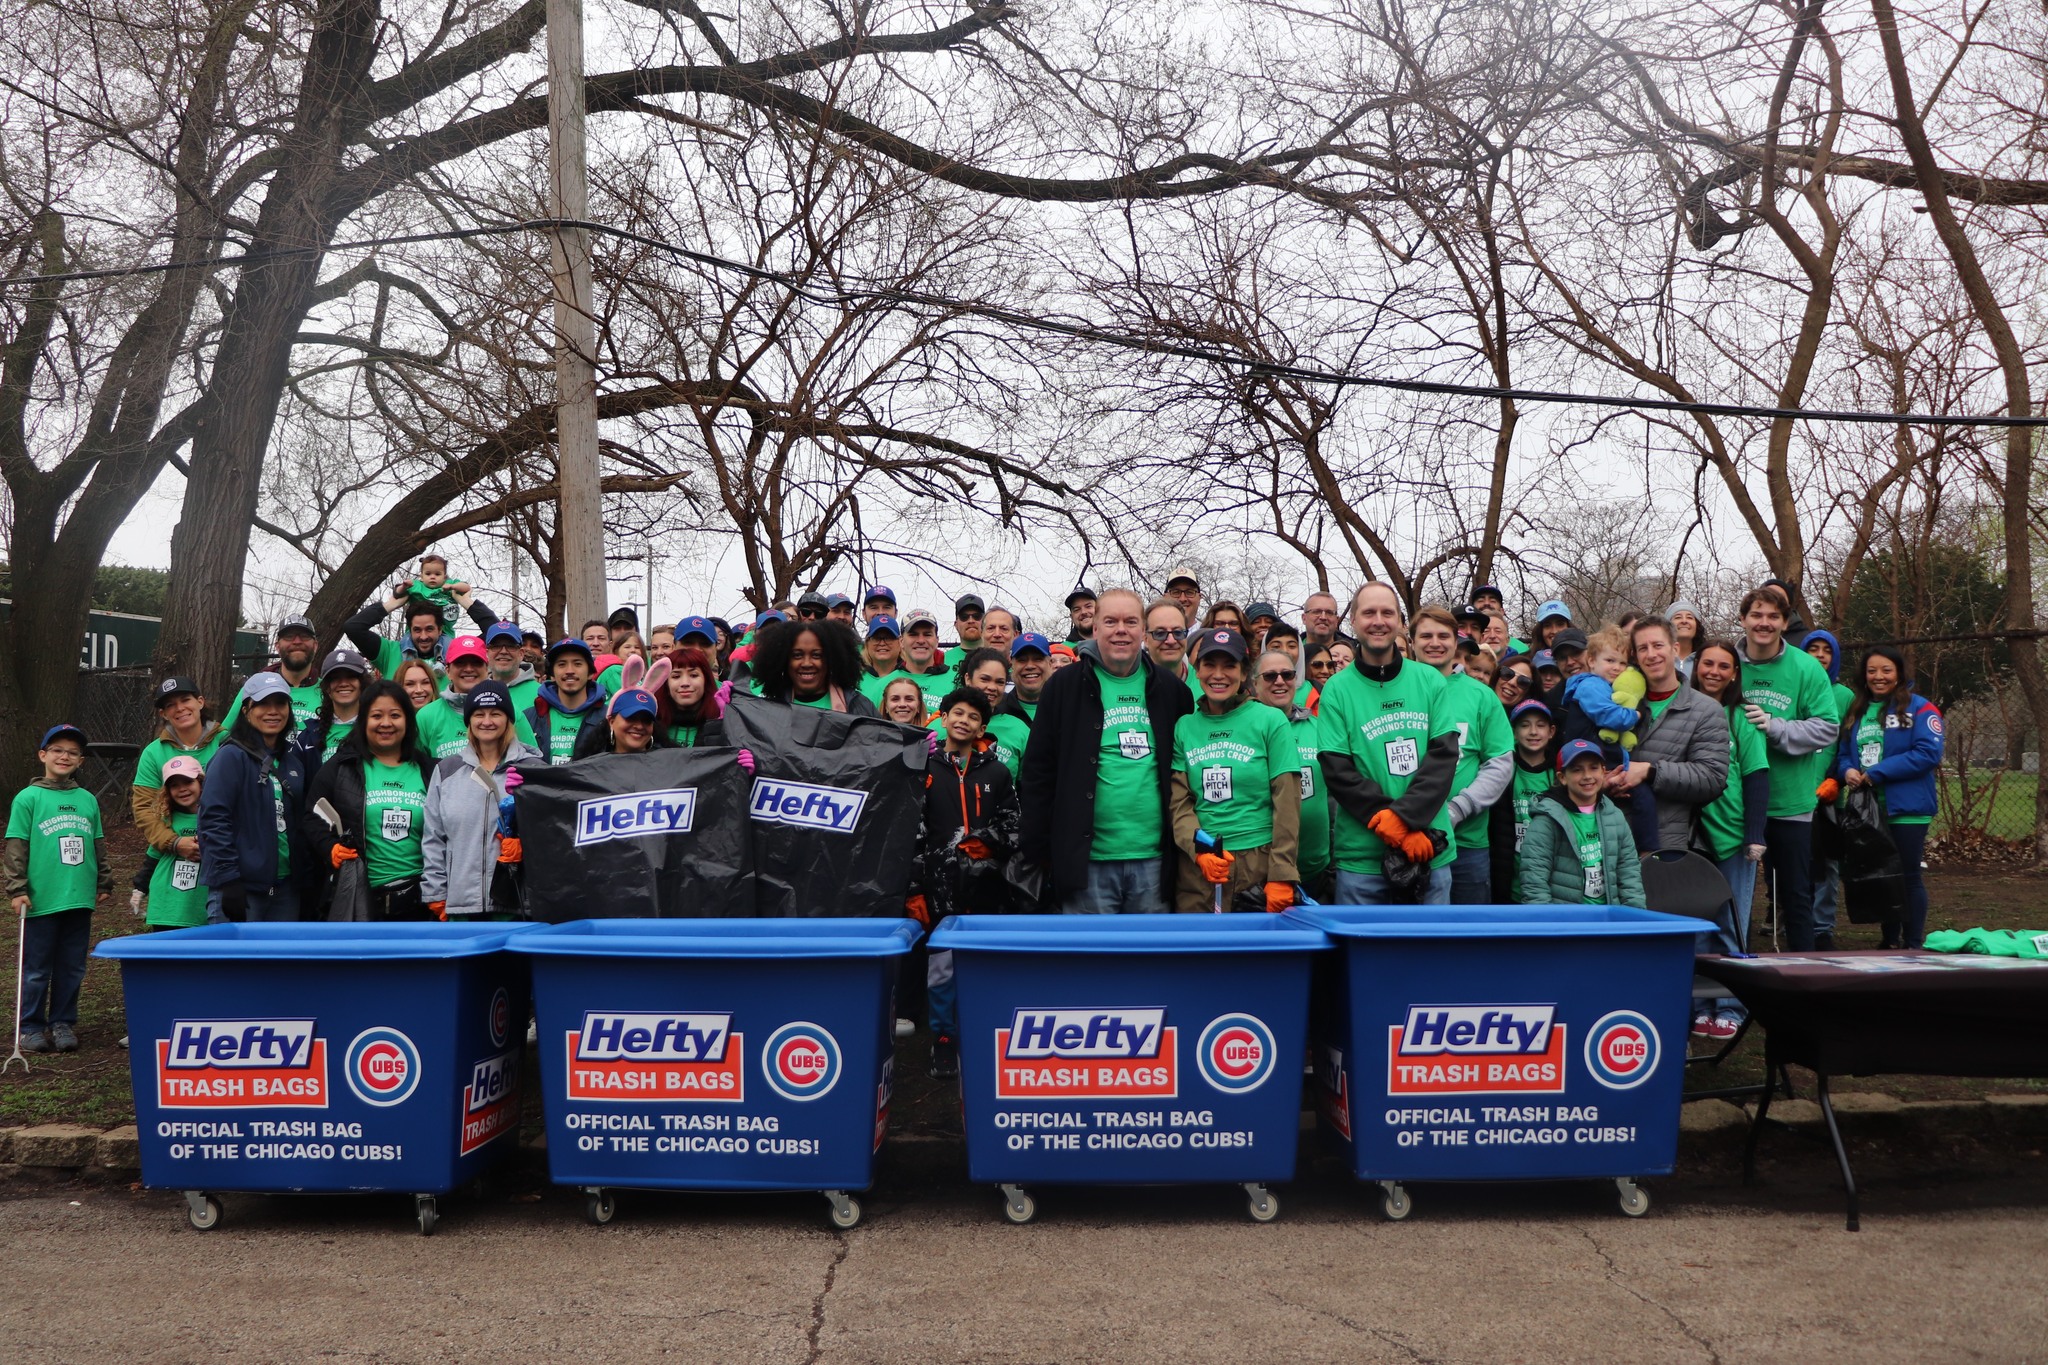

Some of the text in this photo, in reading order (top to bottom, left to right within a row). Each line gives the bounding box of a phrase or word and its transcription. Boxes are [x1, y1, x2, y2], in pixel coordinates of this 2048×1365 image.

[1382, 700, 1404, 709] Hefty
[1742, 689, 1792, 705] IGHBORHOOD
[1768, 698, 1788, 711] CREW
[1140, 717, 1151, 726] CR
[1209, 731, 1231, 739] Hefty
[1366, 720, 1405, 740] GROUNDS
[436, 738, 470, 754] NEIGHBO
[550, 742, 573, 750] OUNDS
[1124, 736, 1144, 744] LET'S
[1186, 741, 1255, 759] NEIGHBORHOOD
[1391, 744, 1412, 755] LET'S
[1189, 750, 1251, 766] GROUNDS CREW
[1391, 753, 1415, 764] PITCH
[1398, 763, 1410, 772] IN!
[1206, 772, 1226, 781] LET'S
[1205, 781, 1228, 790] PITCH
[366, 796, 403, 806] GROUNDS
[1211, 790, 1223, 799] IN!
[754, 785, 853, 827] Hefty
[387, 814, 407, 822] LET'S
[586, 800, 687, 834] Hefty
[42, 821, 77, 836] GROUNDS
[384, 822, 408, 830] PITCH
[390, 829, 401, 838] IN!
[63, 847, 82, 856] PITCH
[64, 840, 81, 848] LET'S
[175, 871, 196, 881] PITCH
[178, 864, 196, 873] LET'S
[587, 1018, 722, 1060] Hefty
[1017, 1015, 1155, 1056] Hefty
[1410, 1012, 1546, 1052] Hefty
[175, 1026, 307, 1066] Hefty
[574, 1070, 735, 1090] TRASH BAGS
[1004, 1067, 1169, 1087] TRASH BAGS
[1396, 1063, 1556, 1083] TRASH BAGS
[165, 1077, 320, 1097] TRASH BAGS
[565, 1113, 779, 1132] OFFICIAL TRASH BAG
[994, 1110, 1213, 1128] OFFICIAL TRASH BAG
[1385, 1106, 1598, 1125] OFFICIAL TRASH BAG
[157, 1121, 362, 1138] OFFICIAL TRASH BAG
[466, 1112, 498, 1142] TRASH
[1007, 1131, 1253, 1150] OF THE CHICAGO CUBS!
[1397, 1126, 1636, 1147] OF THE CHICAGO CUBS!
[169, 1143, 402, 1161] OF THE CHICAGO CUBS!
[578, 1135, 819, 1155] OF THE CHICAGO CUBS!
